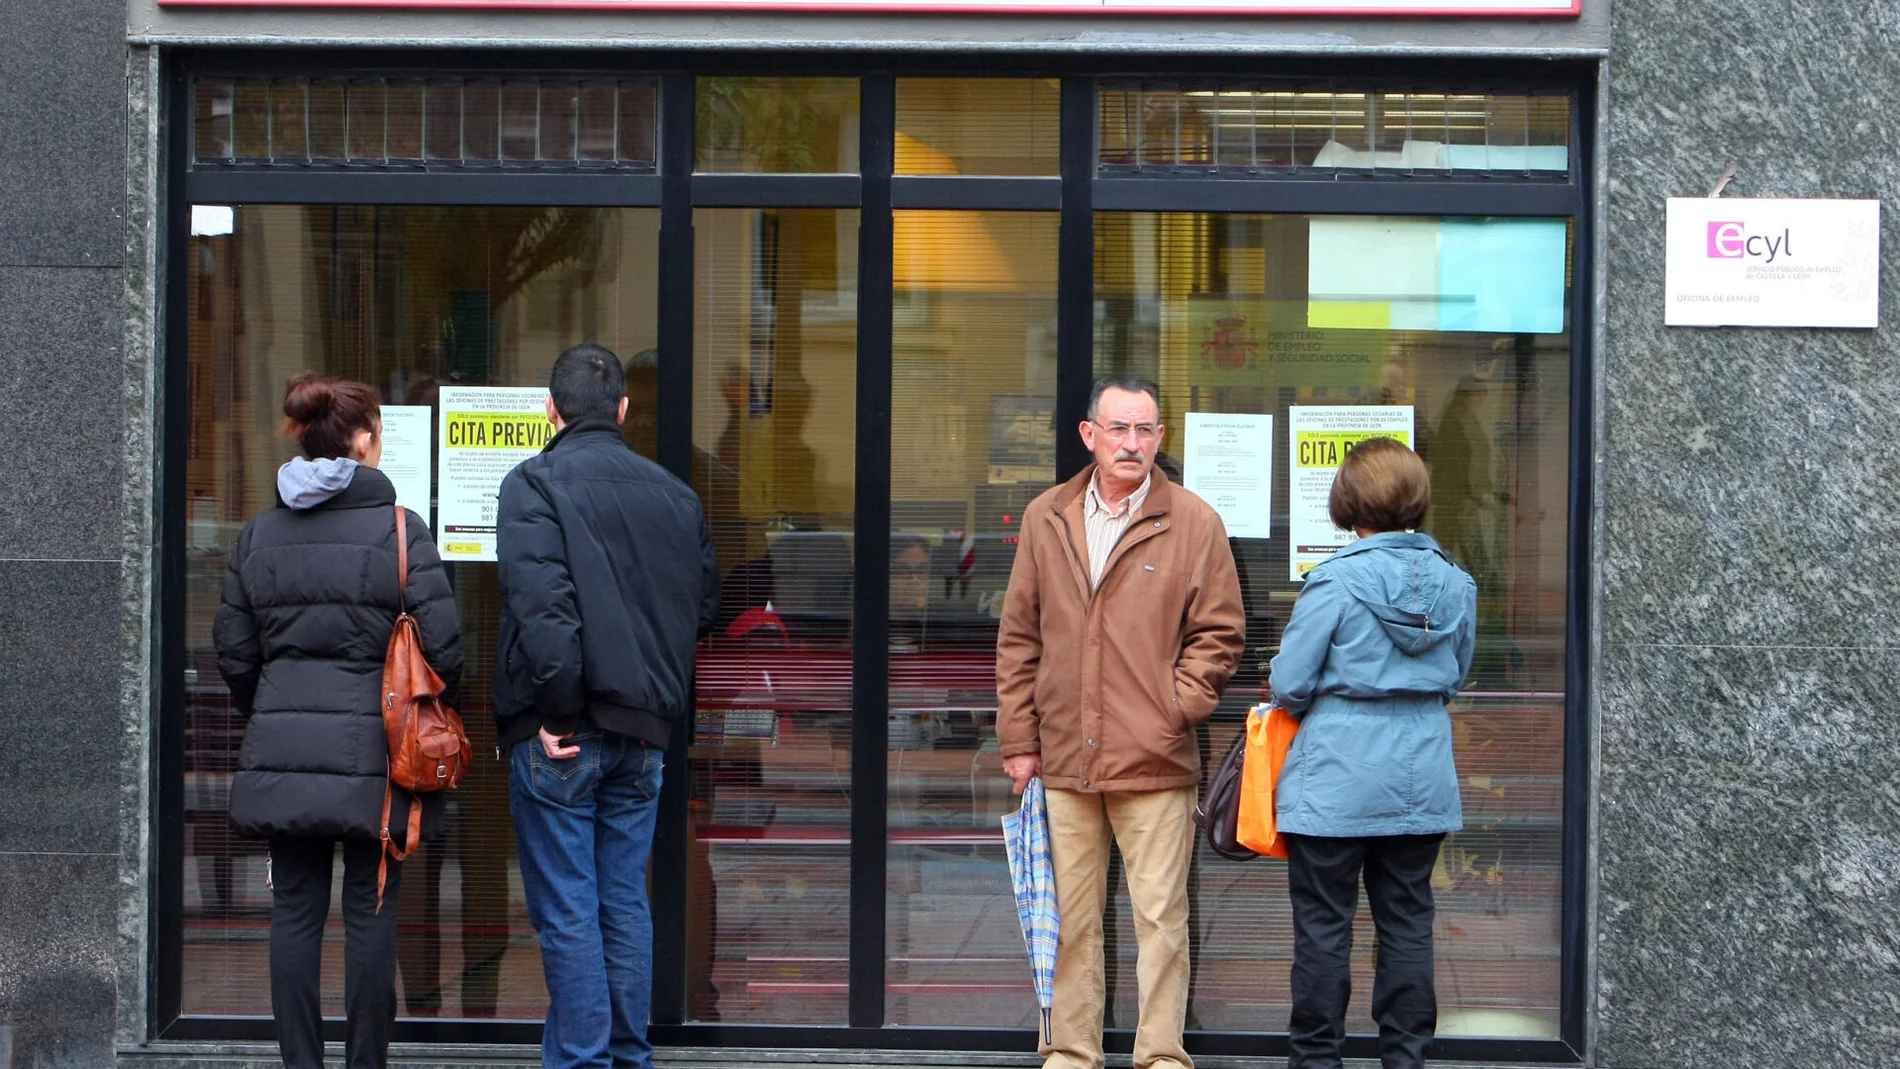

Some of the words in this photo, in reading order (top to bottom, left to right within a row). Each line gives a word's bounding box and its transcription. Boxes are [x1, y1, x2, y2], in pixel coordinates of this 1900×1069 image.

[1714, 222, 1792, 263] ecyl
[1676, 294, 1711, 303] OFICINA
[1712, 294, 1724, 303] DE
[1726, 294, 1760, 303] EMPLEO
[1268, 331, 1324, 341] MINISTERIO
[1268, 342, 1282, 351] DE
[1284, 342, 1322, 351] EMPLEO
[1268, 354, 1274, 363] Y
[1276, 354, 1334, 363] SEGURIDAD
[1335, 354, 1372, 363] SOCIAL
[449, 421, 486, 445] CITA
[492, 422, 553, 447] PREVIA
[1300, 440, 1338, 465] CITA
